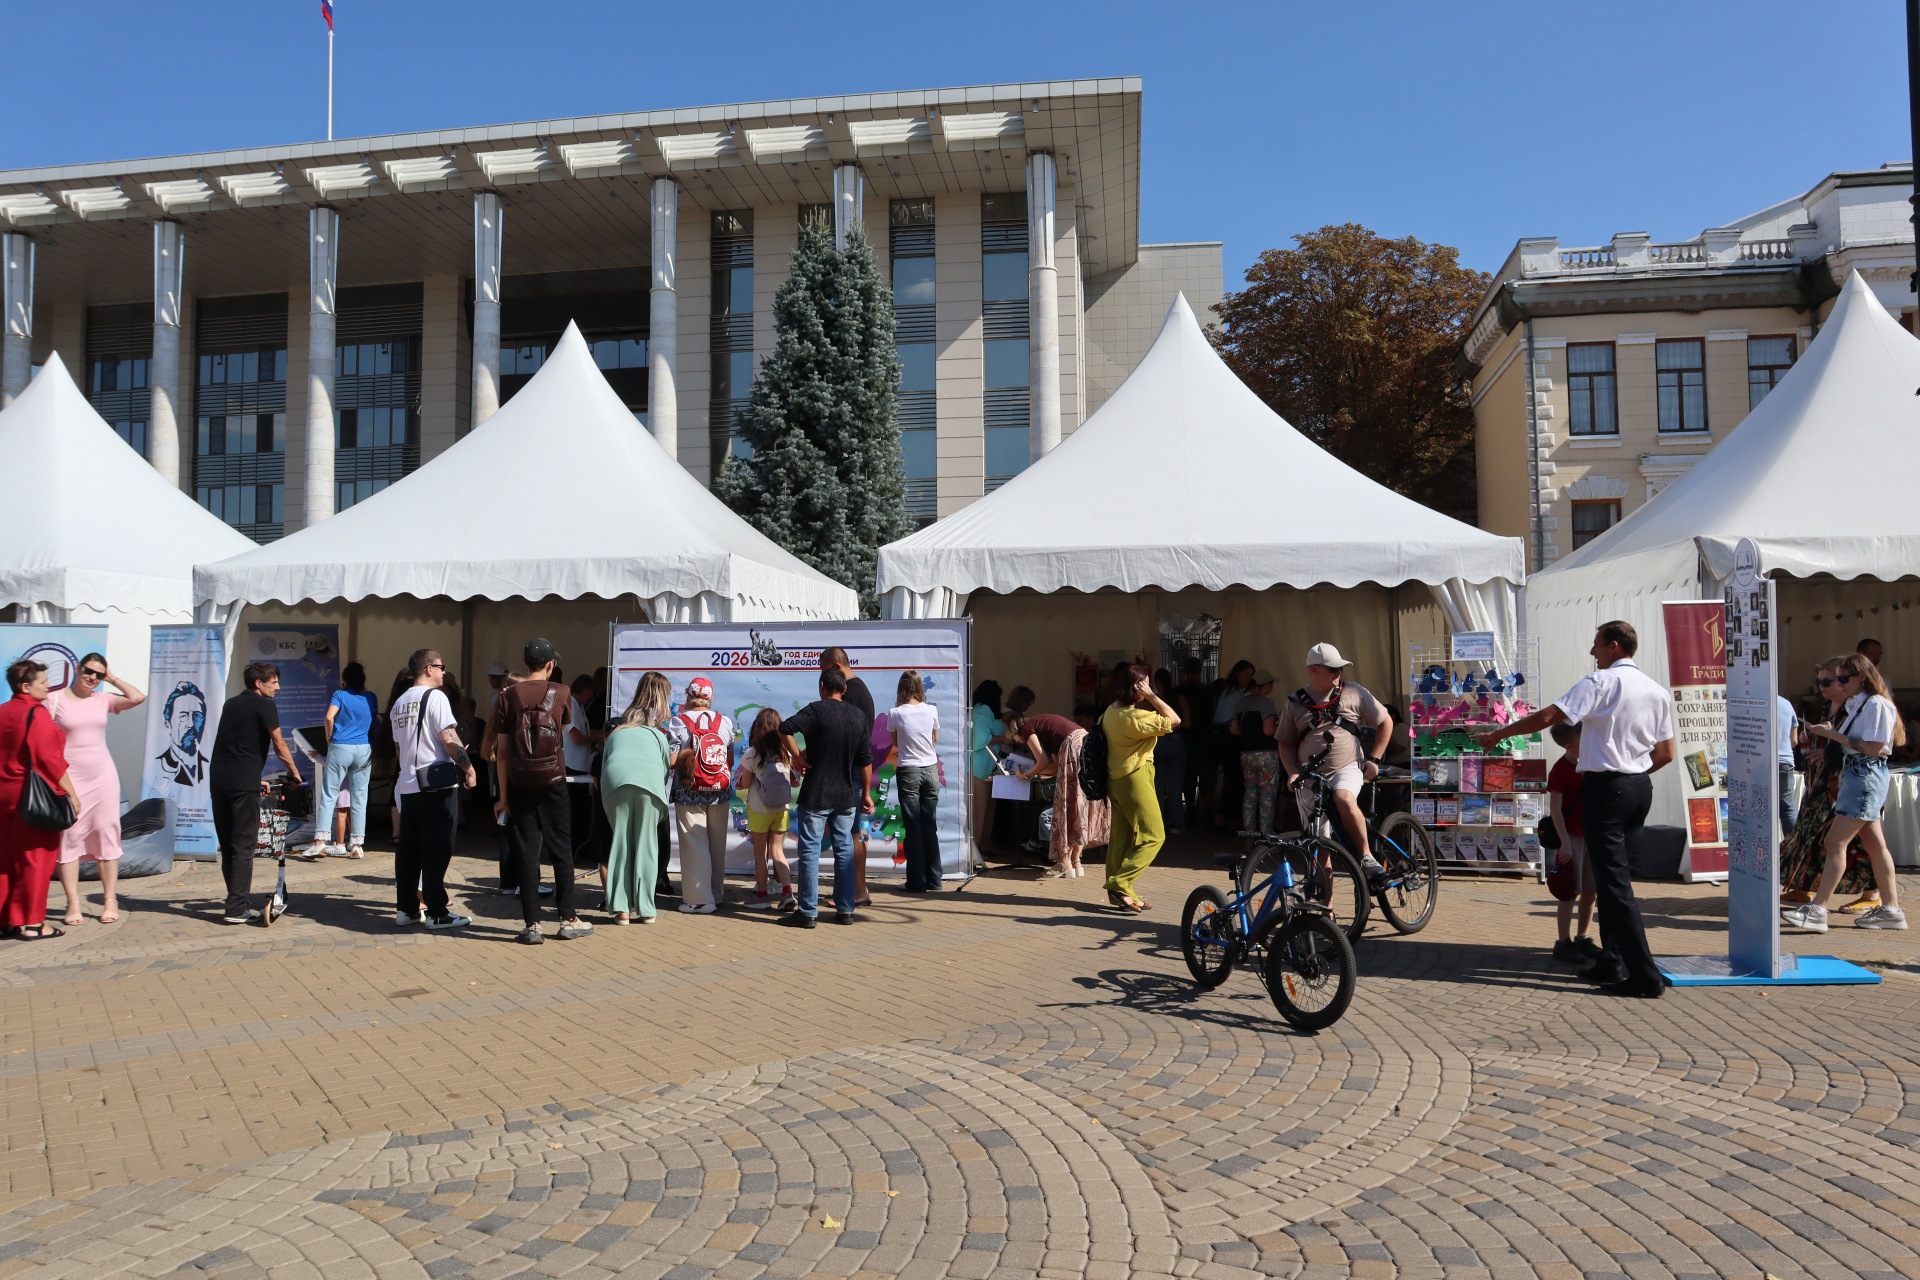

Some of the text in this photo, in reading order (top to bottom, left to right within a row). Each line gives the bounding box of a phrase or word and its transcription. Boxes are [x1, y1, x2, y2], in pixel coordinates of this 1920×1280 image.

[712, 652, 749, 666] 2026
[1689, 666, 1726, 679] ТРАДИ
[1677, 703, 1727, 713] СОХРАНЯЕ
[1679, 717, 1724, 727] ПРОШЛОЕ
[1681, 732, 1726, 744] ДЛЯ БУДУ
